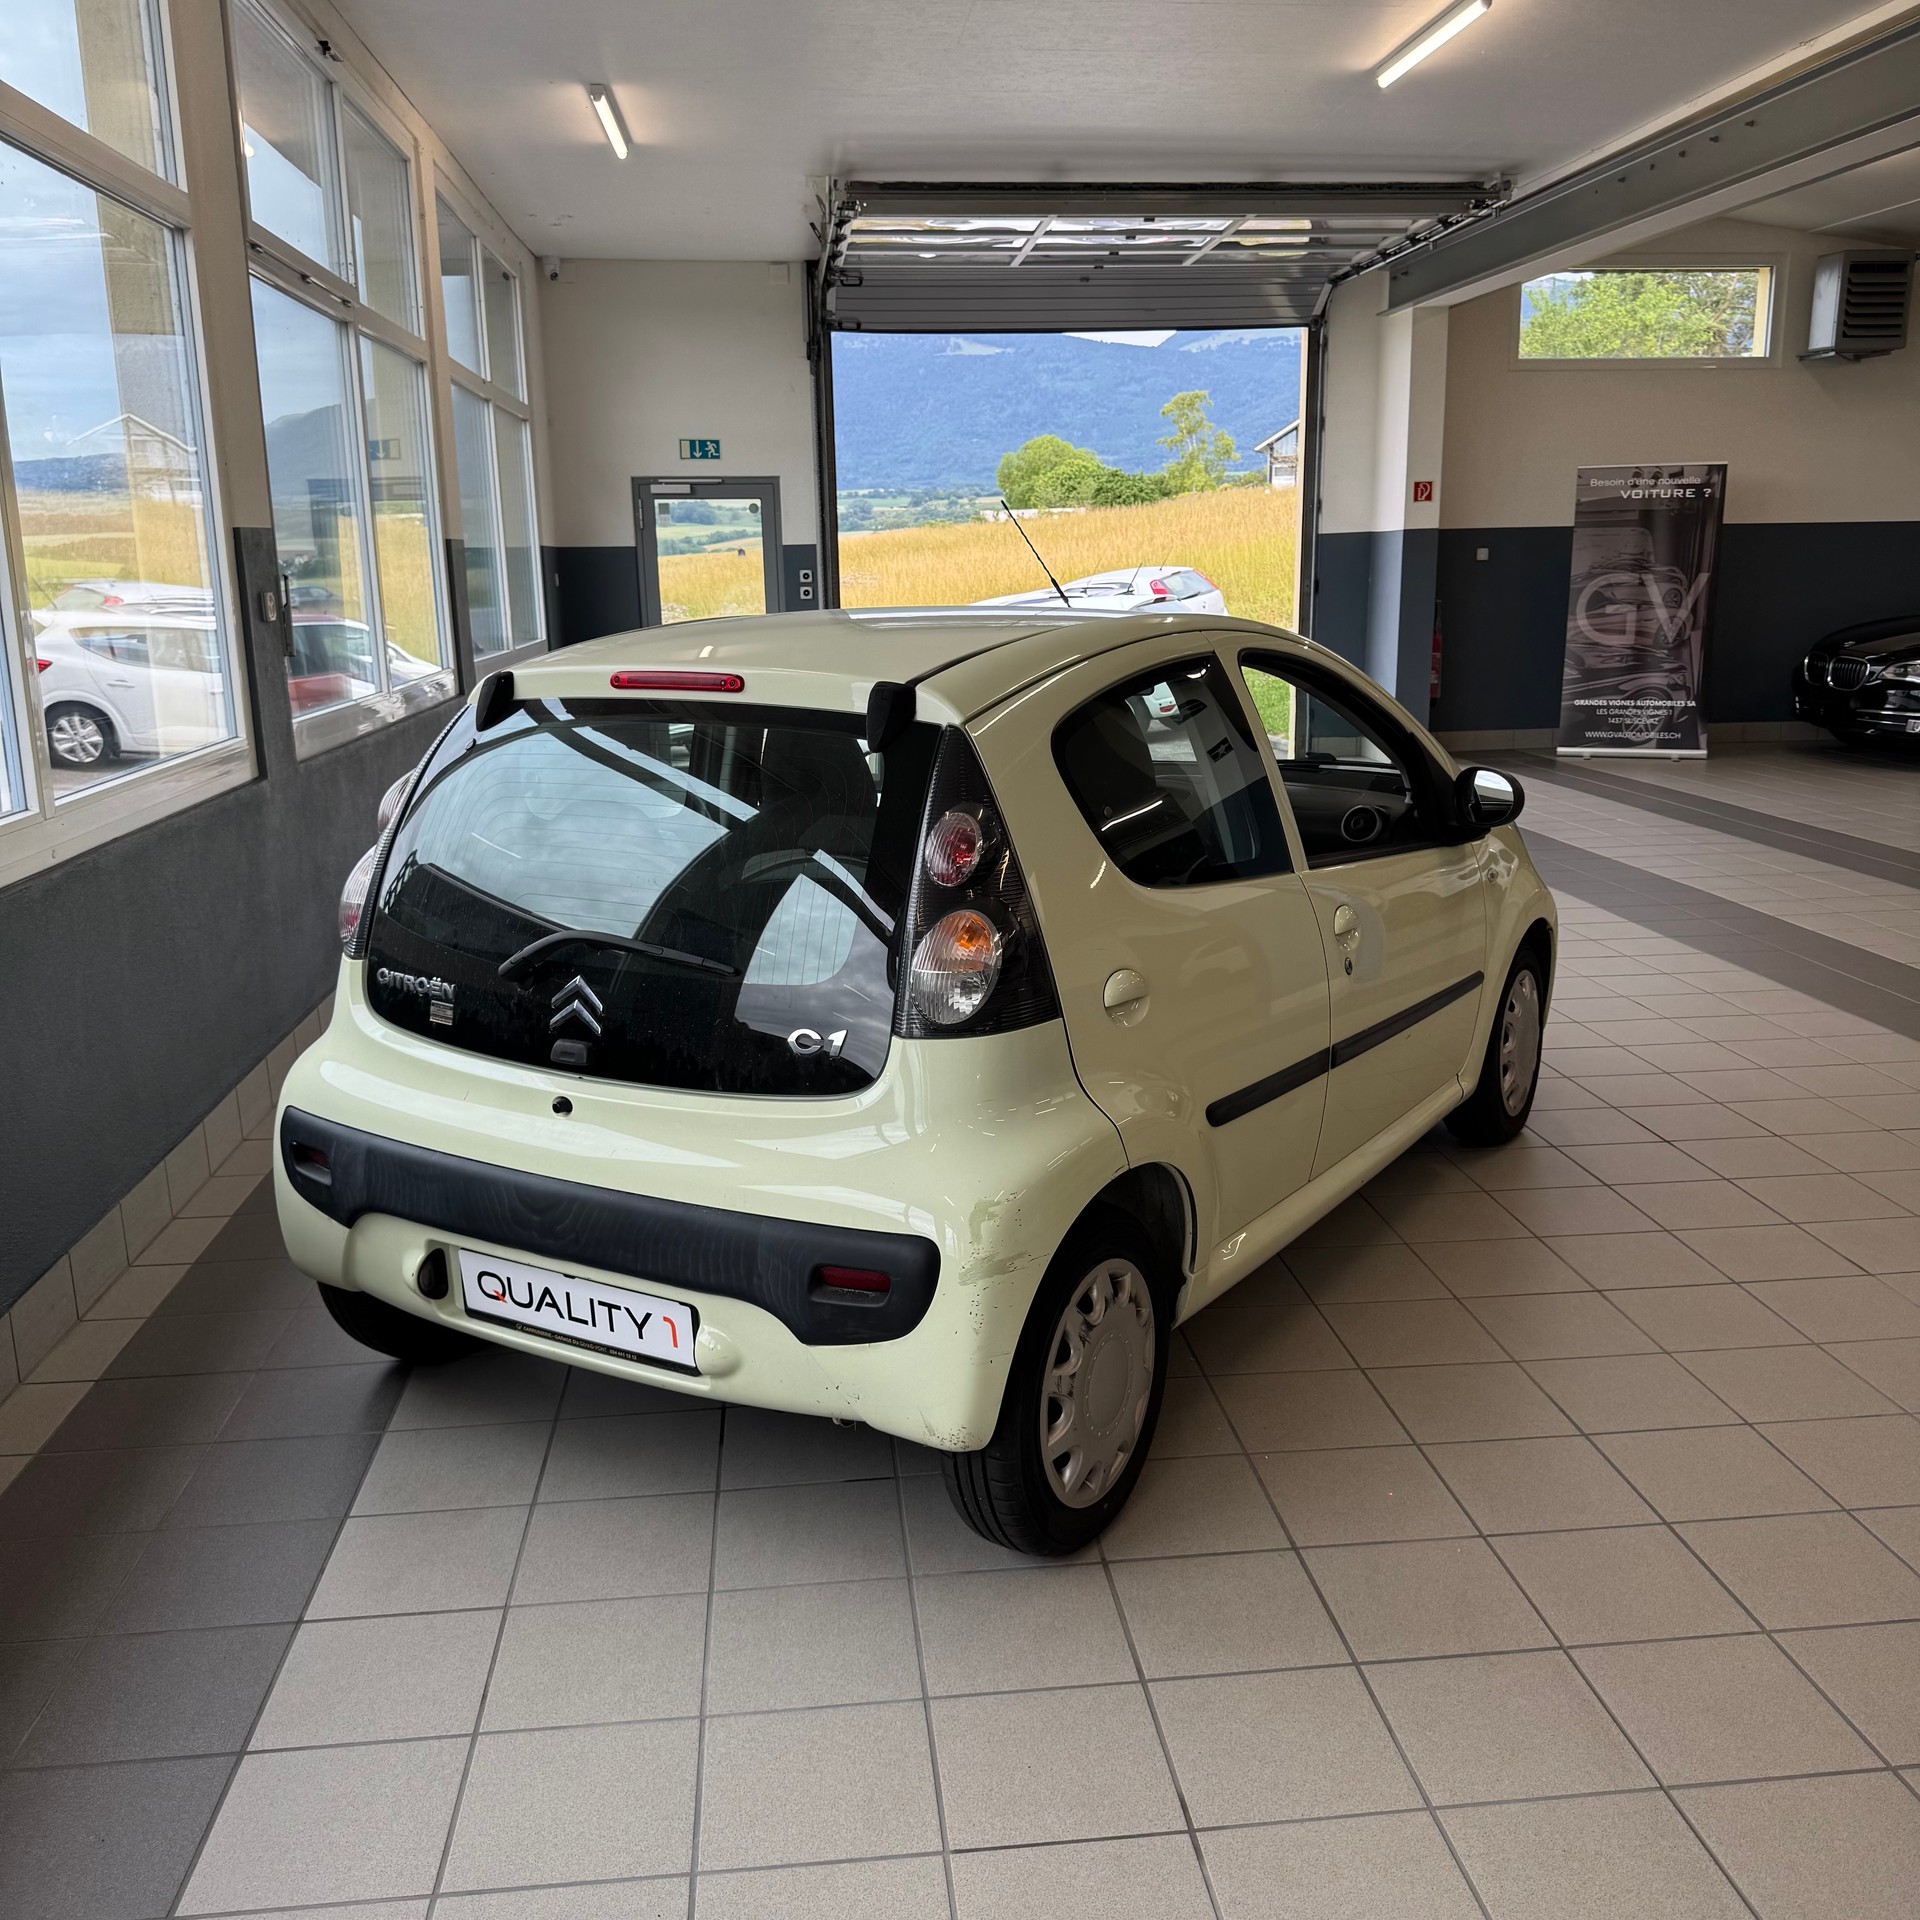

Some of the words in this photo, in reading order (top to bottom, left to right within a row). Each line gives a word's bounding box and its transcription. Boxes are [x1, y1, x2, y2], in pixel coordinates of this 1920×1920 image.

[1590, 478, 1625, 487] Besoin
[1627, 477, 1655, 486] d'une
[1658, 476, 1701, 485] nouvelle
[1620, 488, 1696, 499] VOITURE
[1703, 488, 1712, 498] ?
[1576, 572, 1711, 645] GV
[1573, 699, 1607, 707] GRANDES
[1609, 708, 1641, 716] GRANDES
[1643, 708, 1668, 716] VIGNES
[1585, 731, 1681, 739] WWW.GVAUTOMOBILES.CH
[376, 967, 457, 1000] CITROËN
[786, 1028, 848, 1058] C1
[477, 1270, 653, 1340] QUALITY
[662, 1315, 679, 1349] 1
